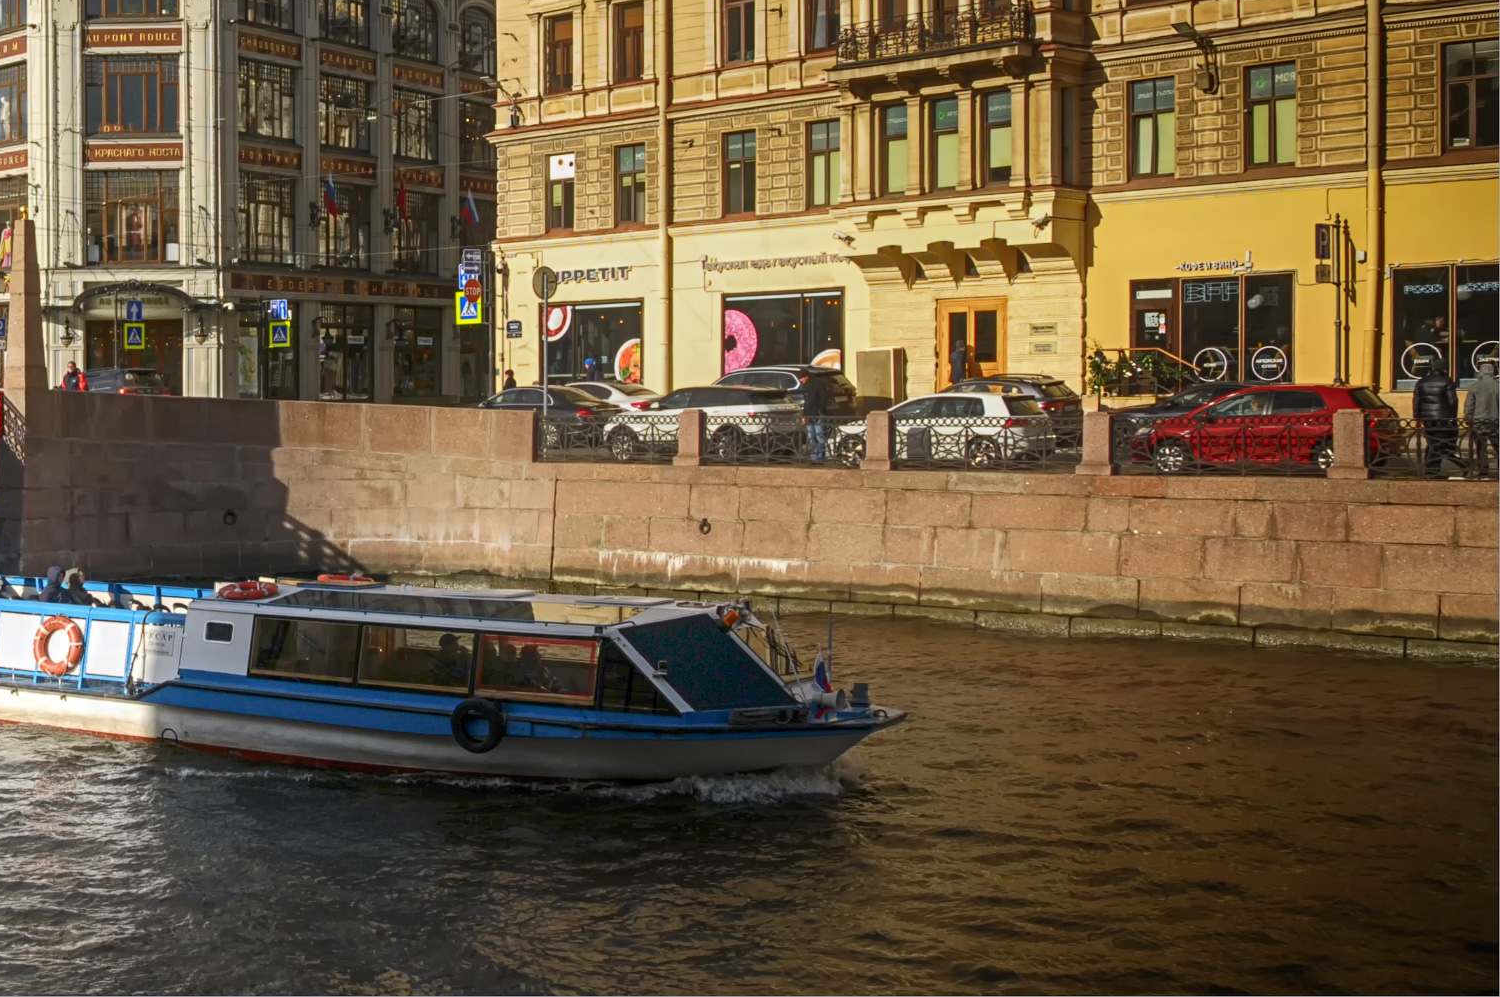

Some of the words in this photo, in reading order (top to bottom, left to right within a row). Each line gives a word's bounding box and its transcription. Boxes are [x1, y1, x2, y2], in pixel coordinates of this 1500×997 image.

[86, 34, 100, 43] AU
[104, 33, 134, 42] PONT
[139, 32, 178, 42] ROUGE
[1275, 71, 1296, 83] МОЯ
[95, 148, 145, 157] КРАСНАГО
[149, 147, 181, 157] МОСТА
[322, 161, 374, 175] СОРОЧКИ
[465, 287, 481, 296] STOP
[1184, 281, 1240, 303] BFF
[1404, 284, 1443, 294] FOOD
